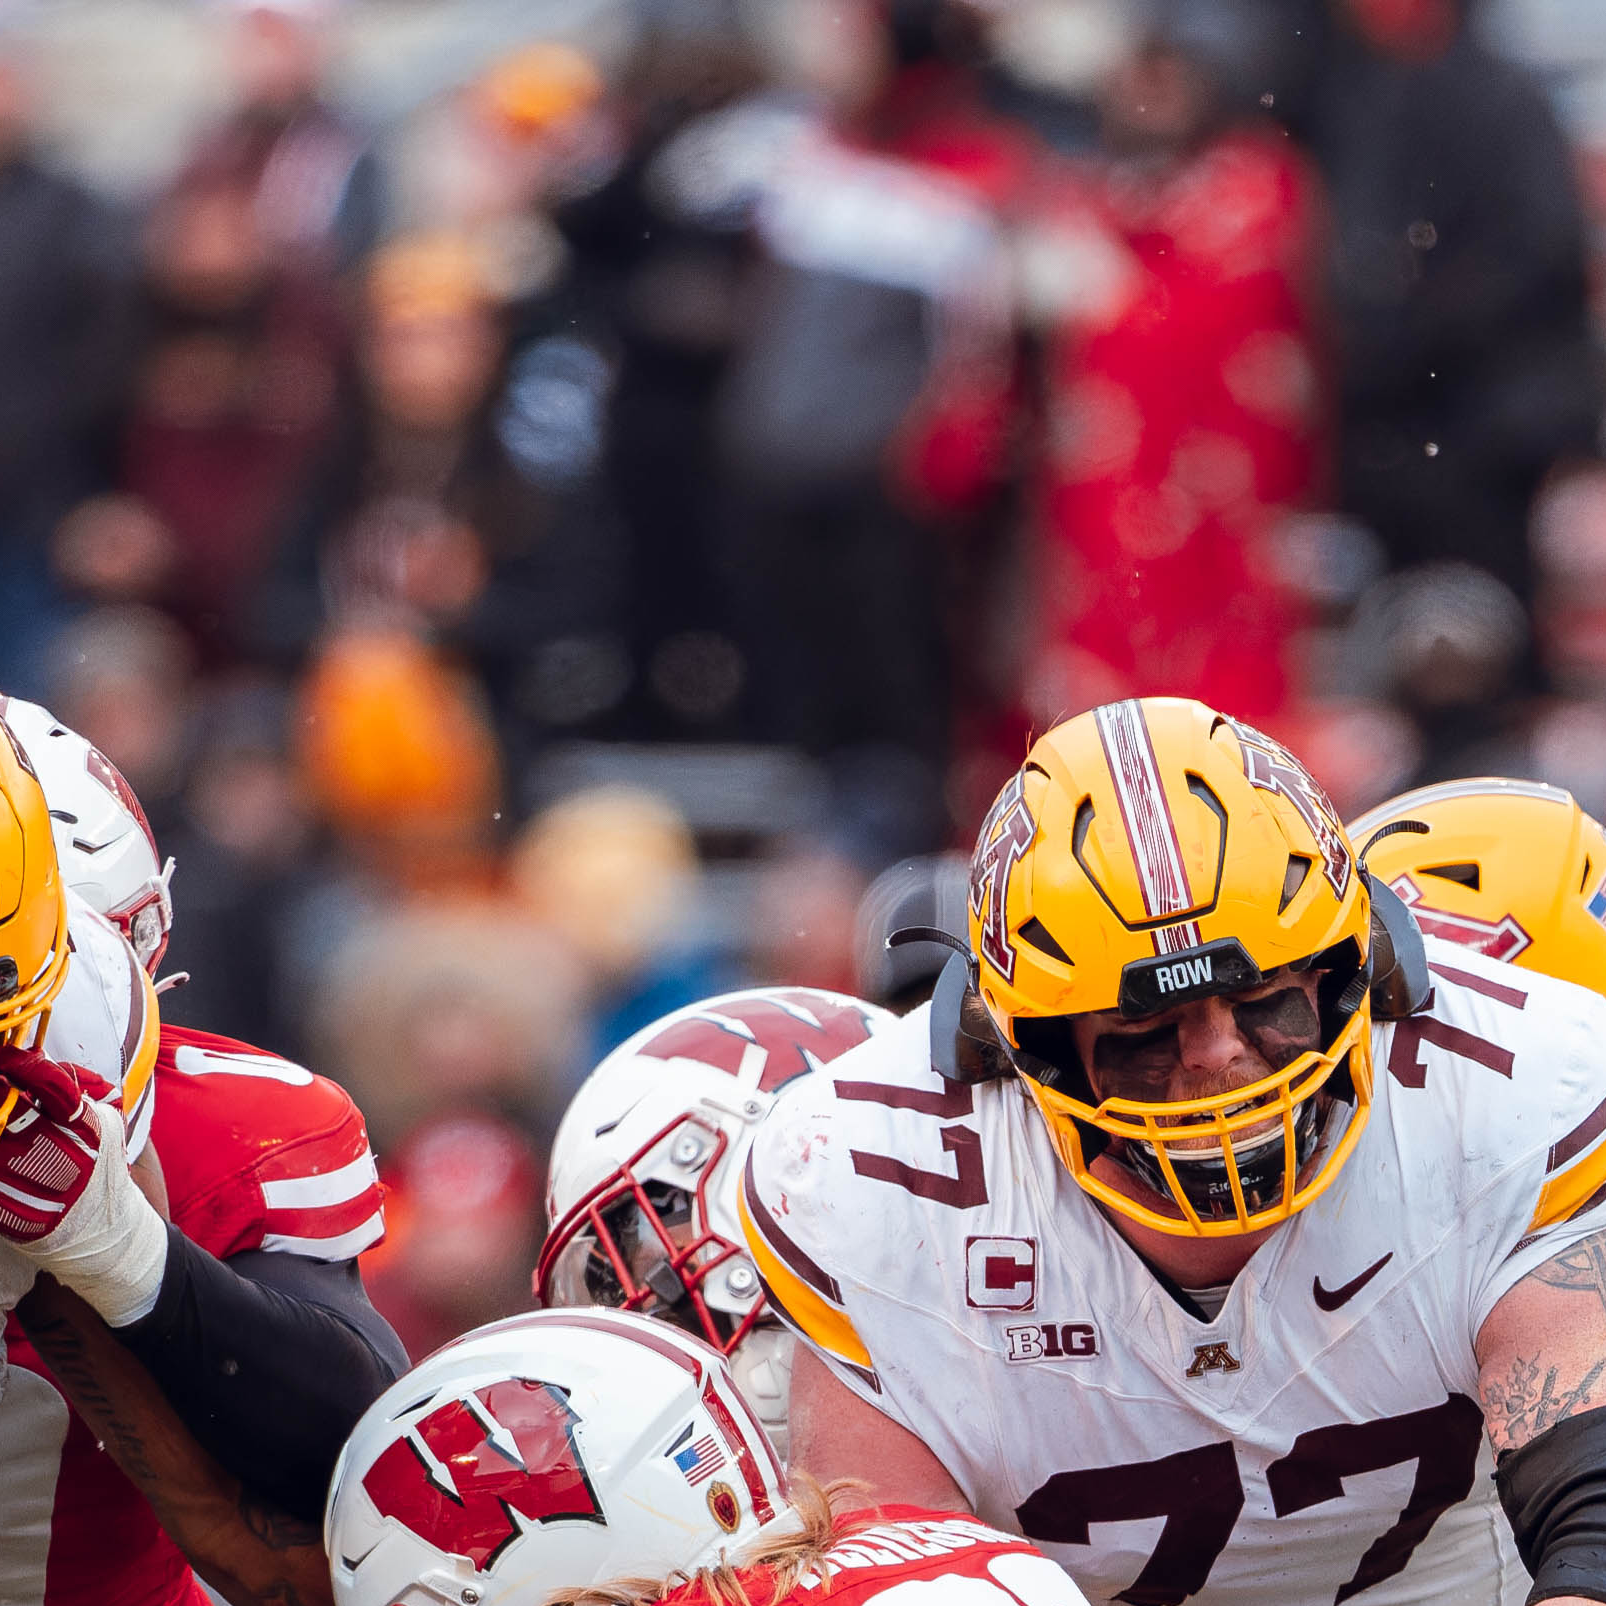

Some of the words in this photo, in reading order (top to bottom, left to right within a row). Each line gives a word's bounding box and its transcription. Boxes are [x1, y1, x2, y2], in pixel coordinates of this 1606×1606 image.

[1155, 955, 1213, 994] ROW
[966, 1238, 1036, 1307] C
[1185, 1341, 1241, 1379] M
